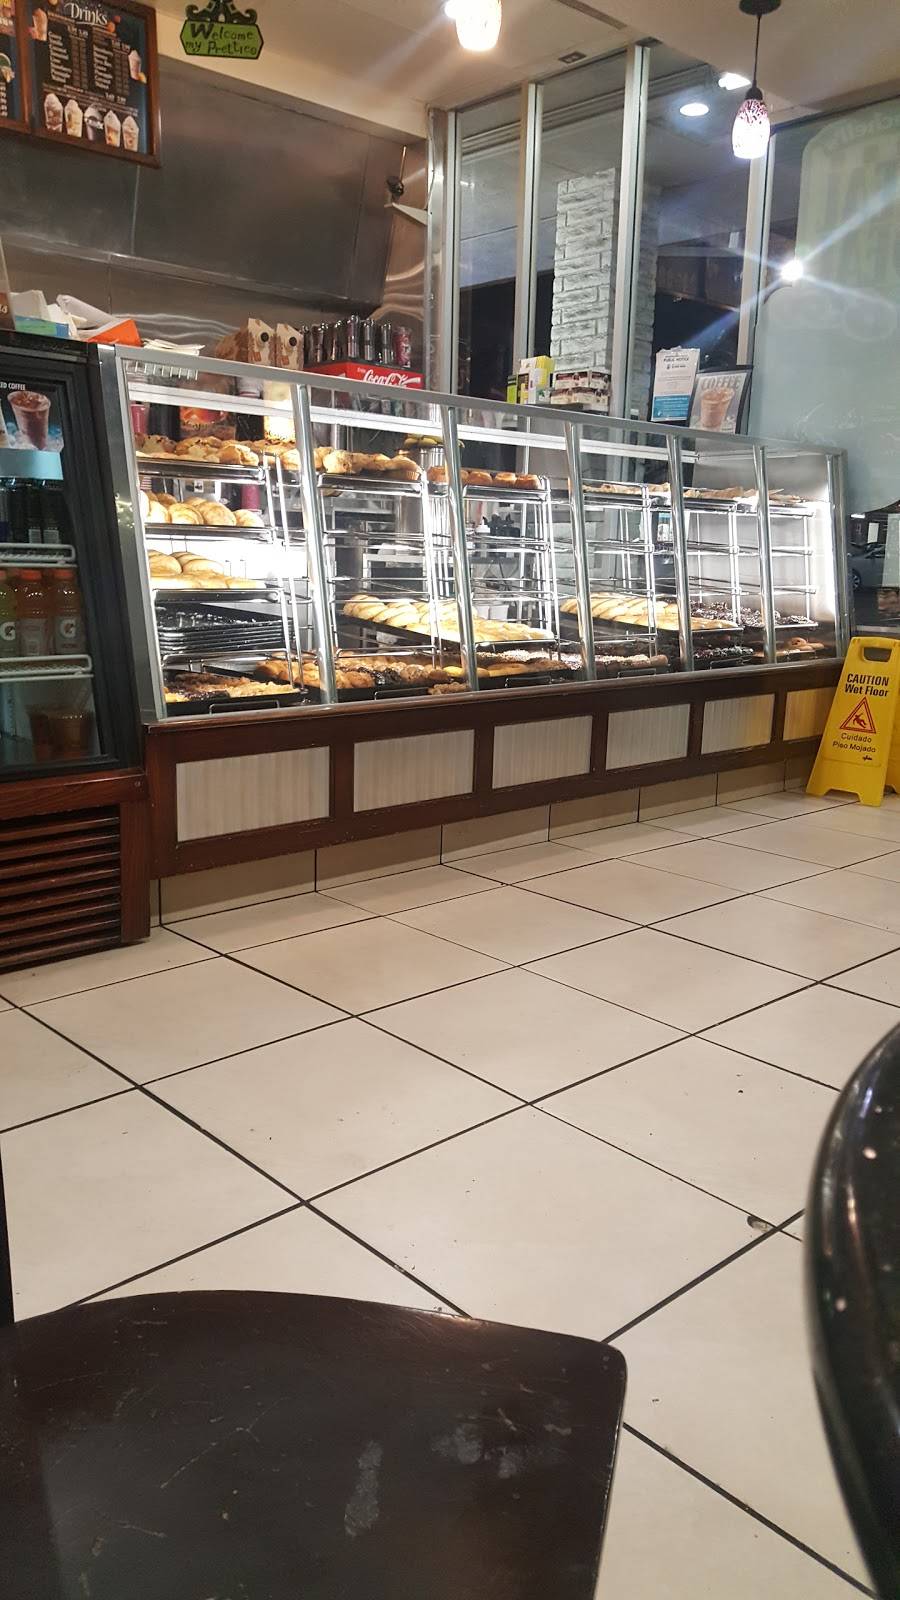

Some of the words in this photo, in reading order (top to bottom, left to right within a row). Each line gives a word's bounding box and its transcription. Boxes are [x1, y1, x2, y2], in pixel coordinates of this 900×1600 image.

[64, 3, 108, 25] Drinks
[190, 23, 253, 40] Welcome
[186, 41, 202, 52] my
[8, 382, 26, 391] COFFEE
[701, 376, 741, 390] COFFEE
[0, 621, 16, 641] G
[61, 619, 76, 638] G
[846, 673, 889, 686] CAUTION
[844, 683, 863, 695] Wet
[865, 685, 889, 697] Floor
[841, 733, 872, 743] Cuidado
[832, 740, 848, 749] Piso
[849, 743, 876, 753] Mojado
